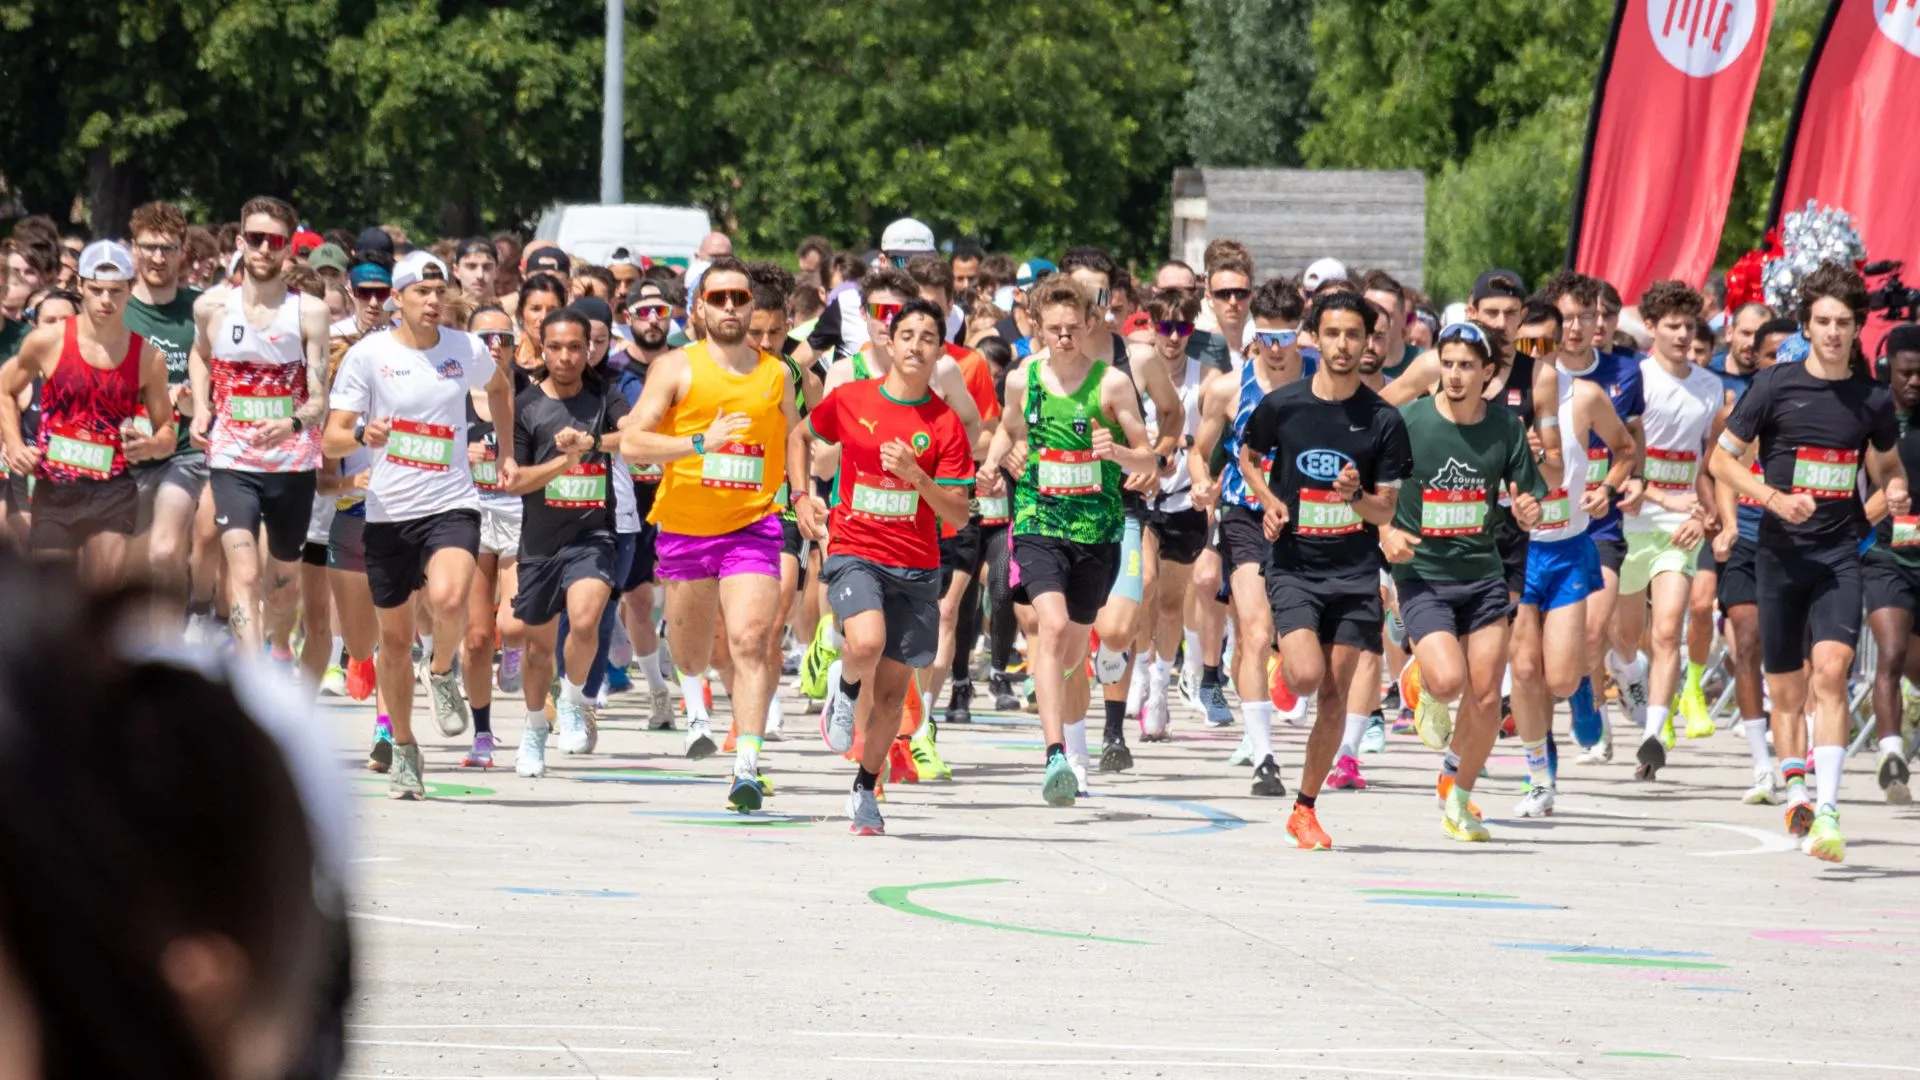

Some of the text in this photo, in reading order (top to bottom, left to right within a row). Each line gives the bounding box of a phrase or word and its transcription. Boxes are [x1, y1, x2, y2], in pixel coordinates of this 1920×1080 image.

[243, 399, 285, 419] 3014
[400, 436, 445, 461] 3249
[719, 456, 755, 480] 3111
[1050, 464, 1093, 485] 3319
[1649, 461, 1690, 482] 3036
[1804, 463, 1851, 488] 3029
[559, 478, 598, 498] 3277
[863, 490, 912, 513] 3436
